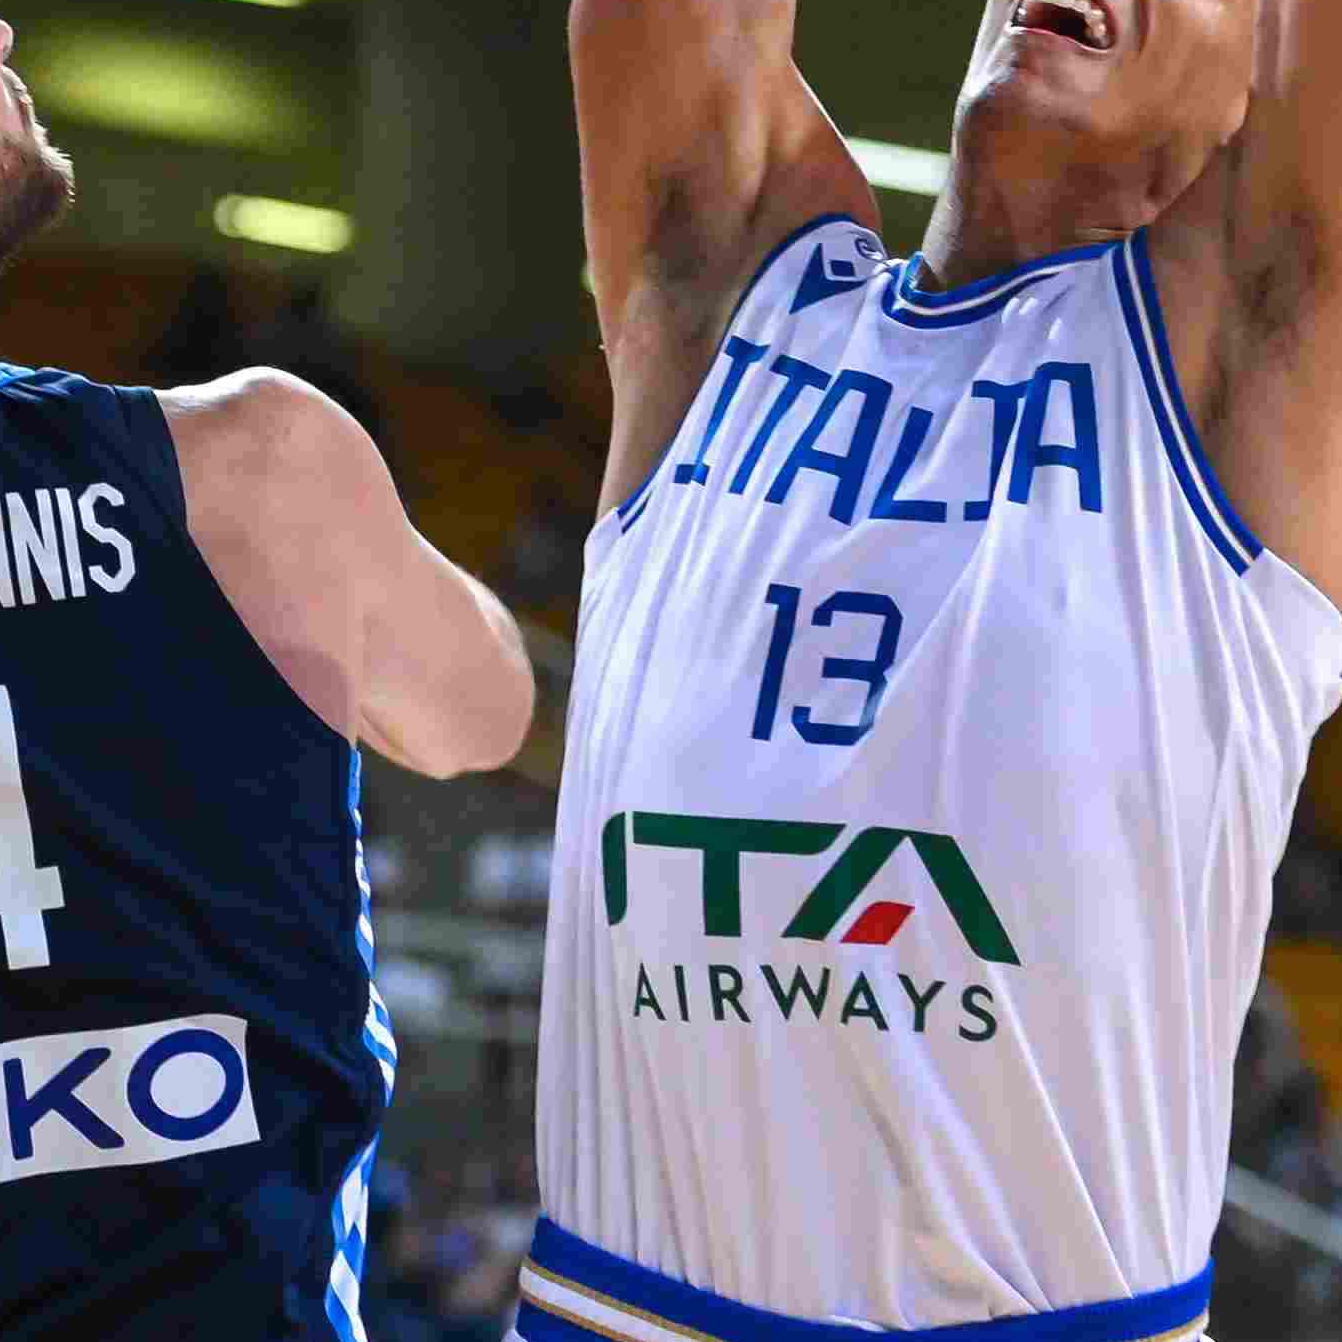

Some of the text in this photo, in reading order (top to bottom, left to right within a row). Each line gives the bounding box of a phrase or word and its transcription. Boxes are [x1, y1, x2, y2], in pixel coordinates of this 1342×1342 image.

[672, 336, 1104, 526] ITALIA
[750, 583, 903, 747] 13
[602, 810, 1022, 967] ITA
[632, 962, 999, 1044] AIRWAYS
